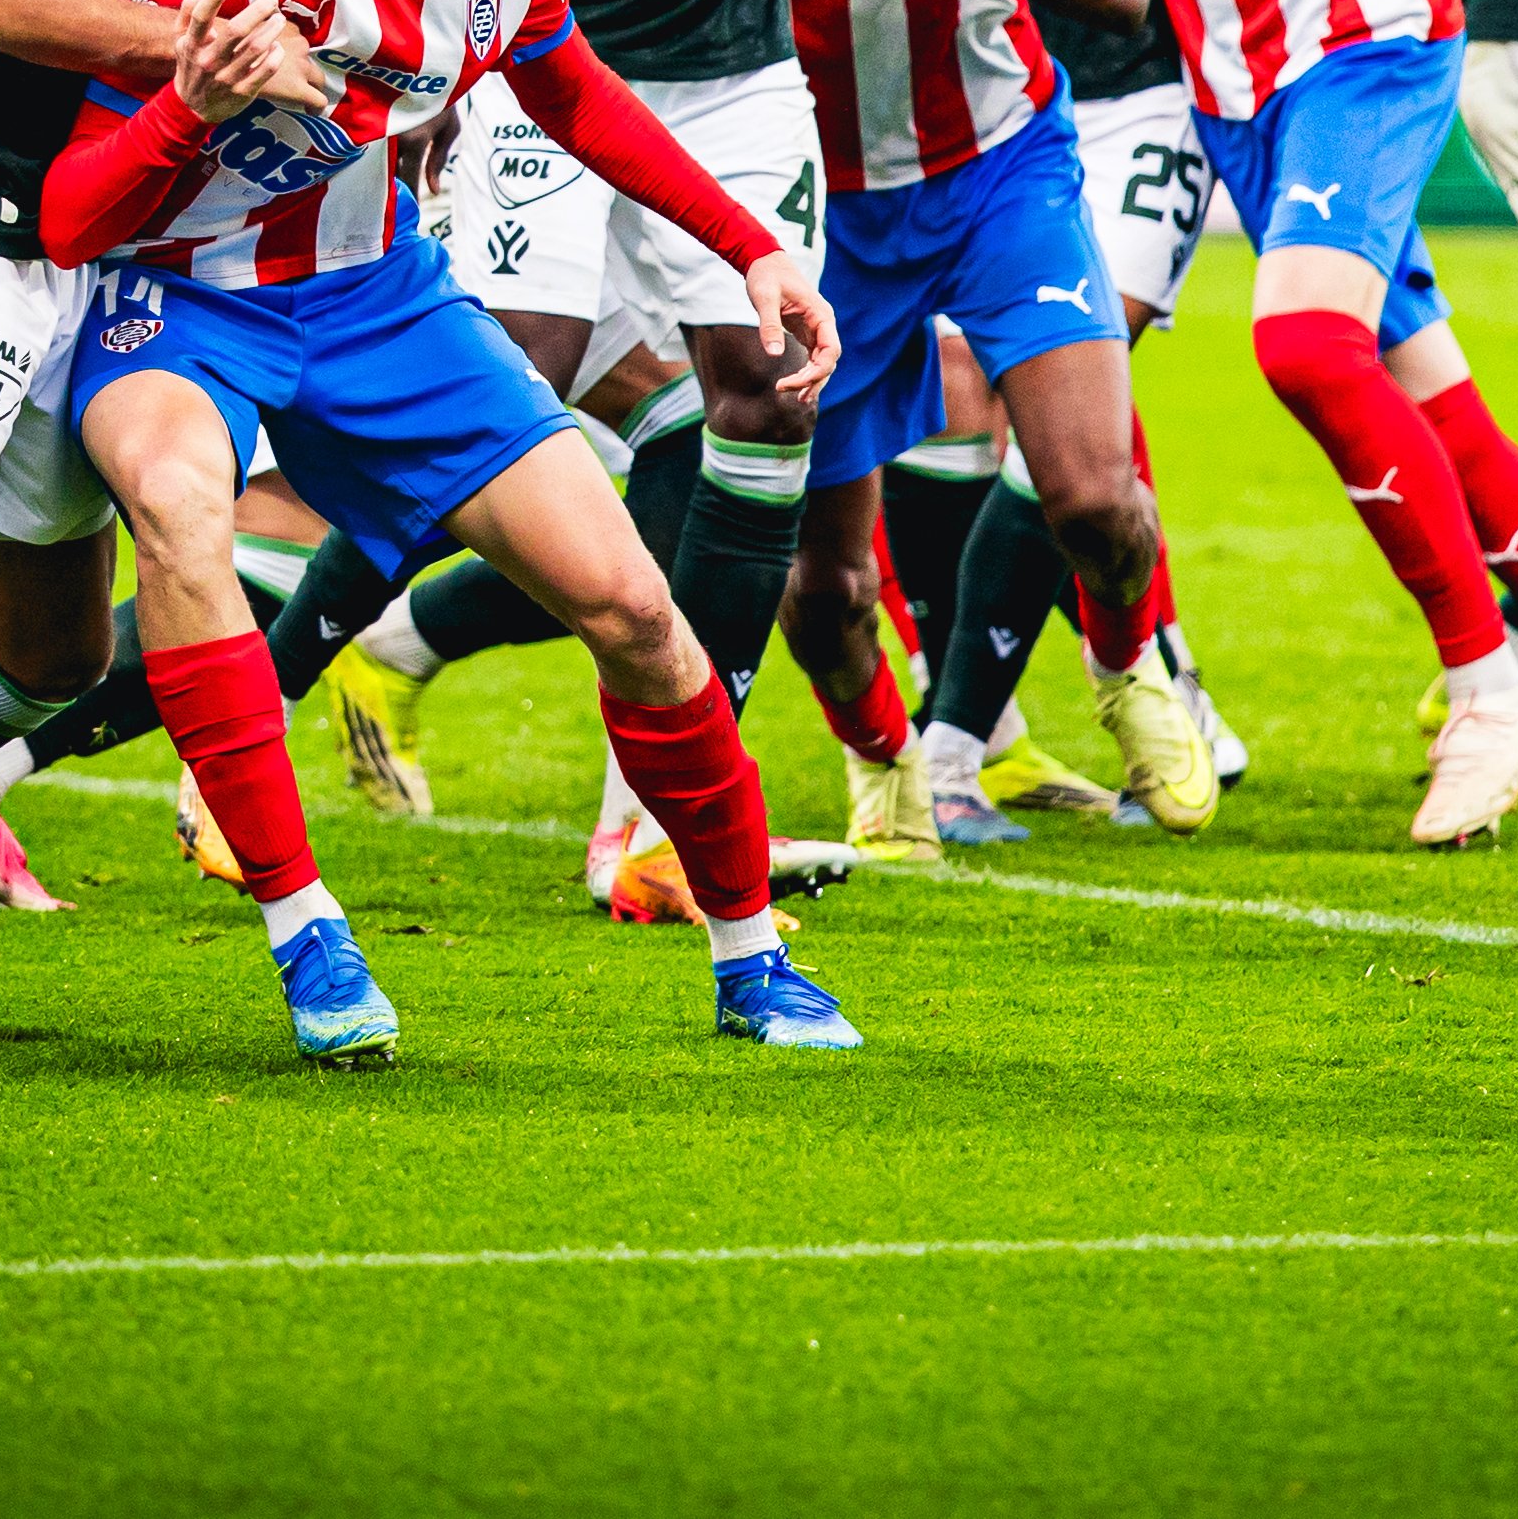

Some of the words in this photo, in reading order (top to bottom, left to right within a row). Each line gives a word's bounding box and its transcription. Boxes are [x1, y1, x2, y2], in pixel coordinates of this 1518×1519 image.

[316, 48, 448, 96] Chance
[497, 157, 551, 180] MOL
[1121, 142, 1203, 235] 25
[775, 159, 817, 249] 4
